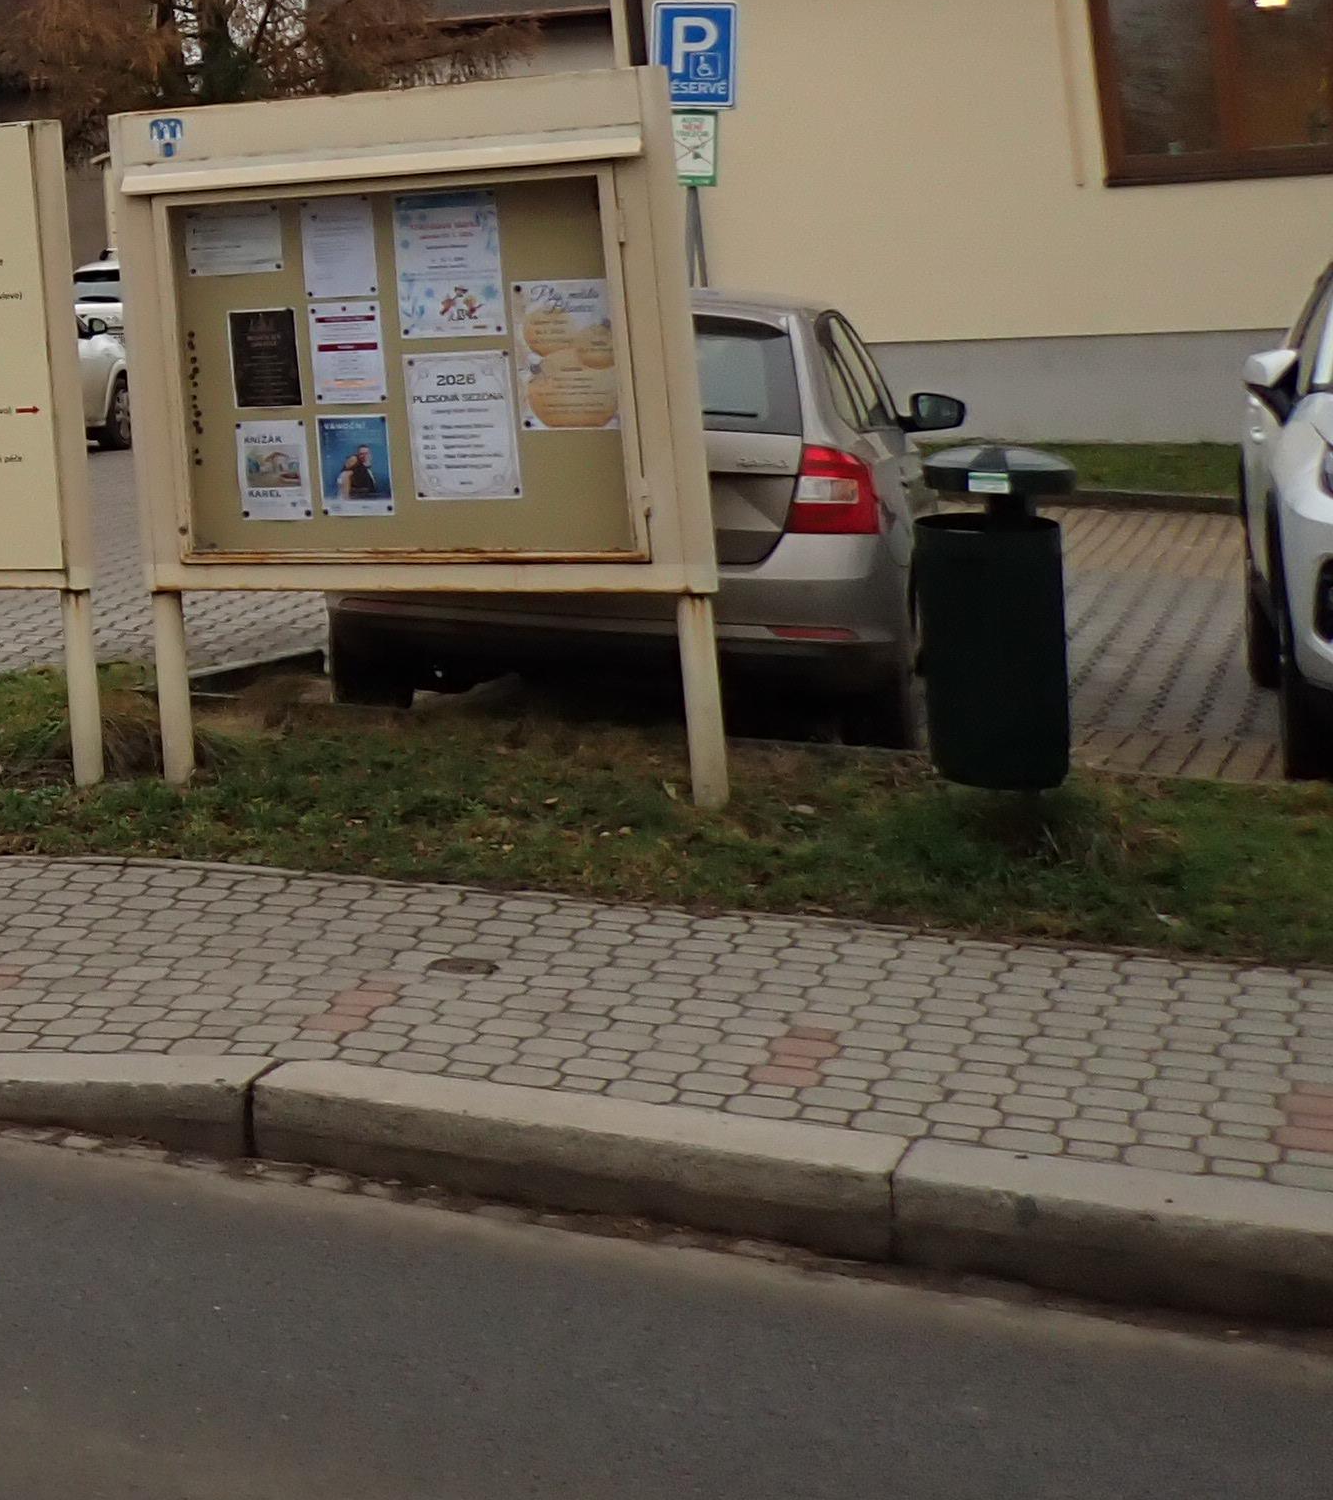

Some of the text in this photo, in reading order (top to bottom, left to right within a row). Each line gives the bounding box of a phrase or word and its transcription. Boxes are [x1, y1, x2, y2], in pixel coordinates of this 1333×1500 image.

[672, 17, 718, 73] P
[670, 79, 727, 95] ÉSERVÉ
[436, 374, 476, 387] 2026
[247, 490, 282, 498] KAREL
